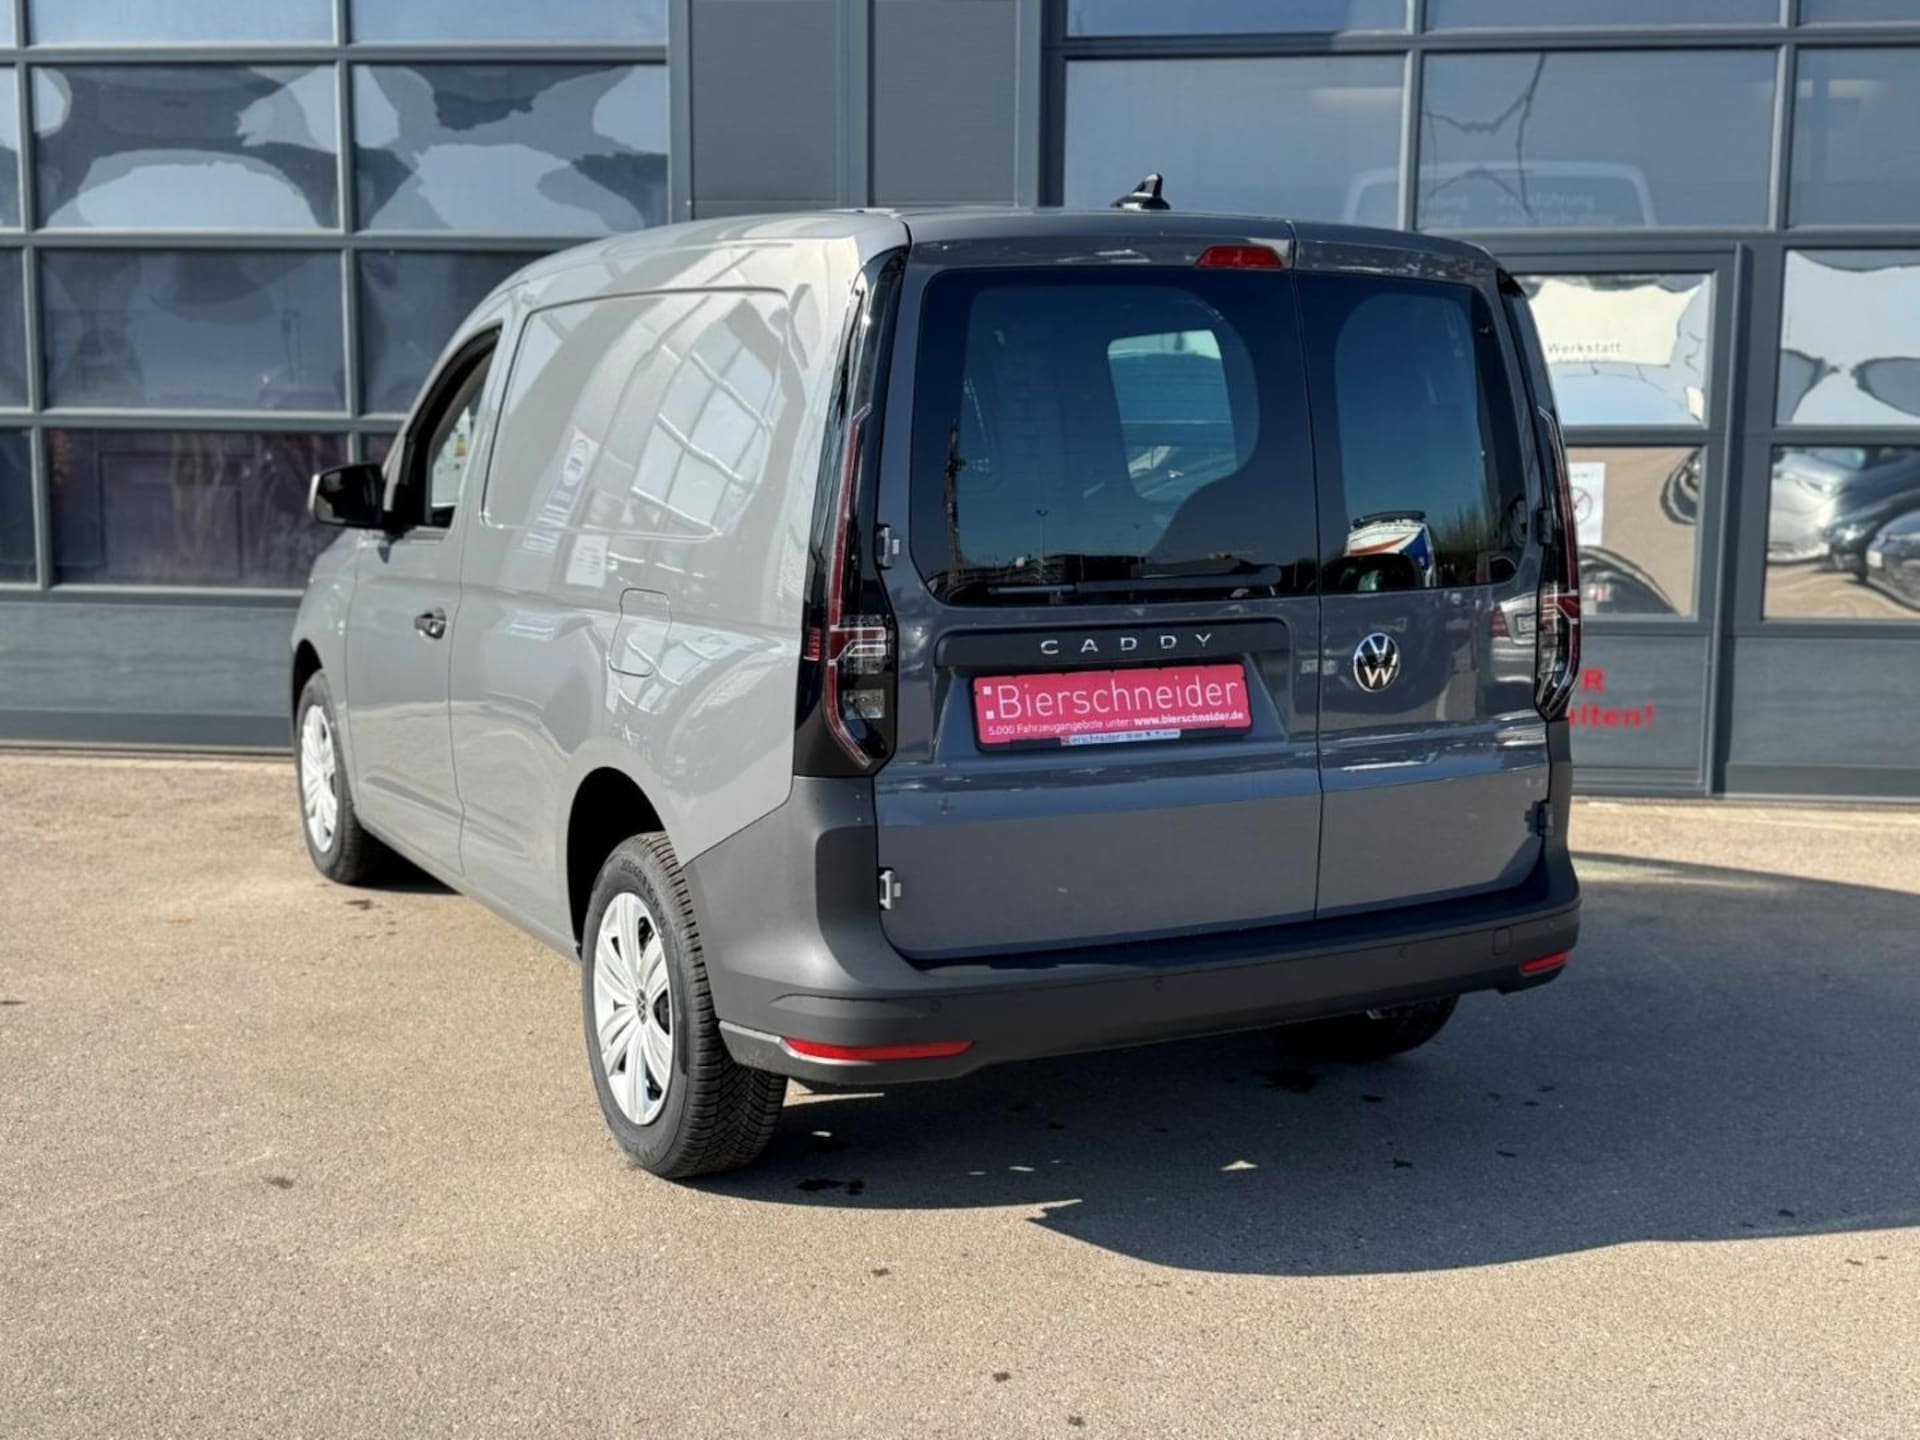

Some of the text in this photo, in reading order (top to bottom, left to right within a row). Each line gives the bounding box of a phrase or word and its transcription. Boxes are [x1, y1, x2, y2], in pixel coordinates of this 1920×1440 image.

[1040, 632, 1212, 655] CADDY
[997, 675, 1239, 719] Bierschneider
[1134, 710, 1244, 726] www.bierschneider.de
